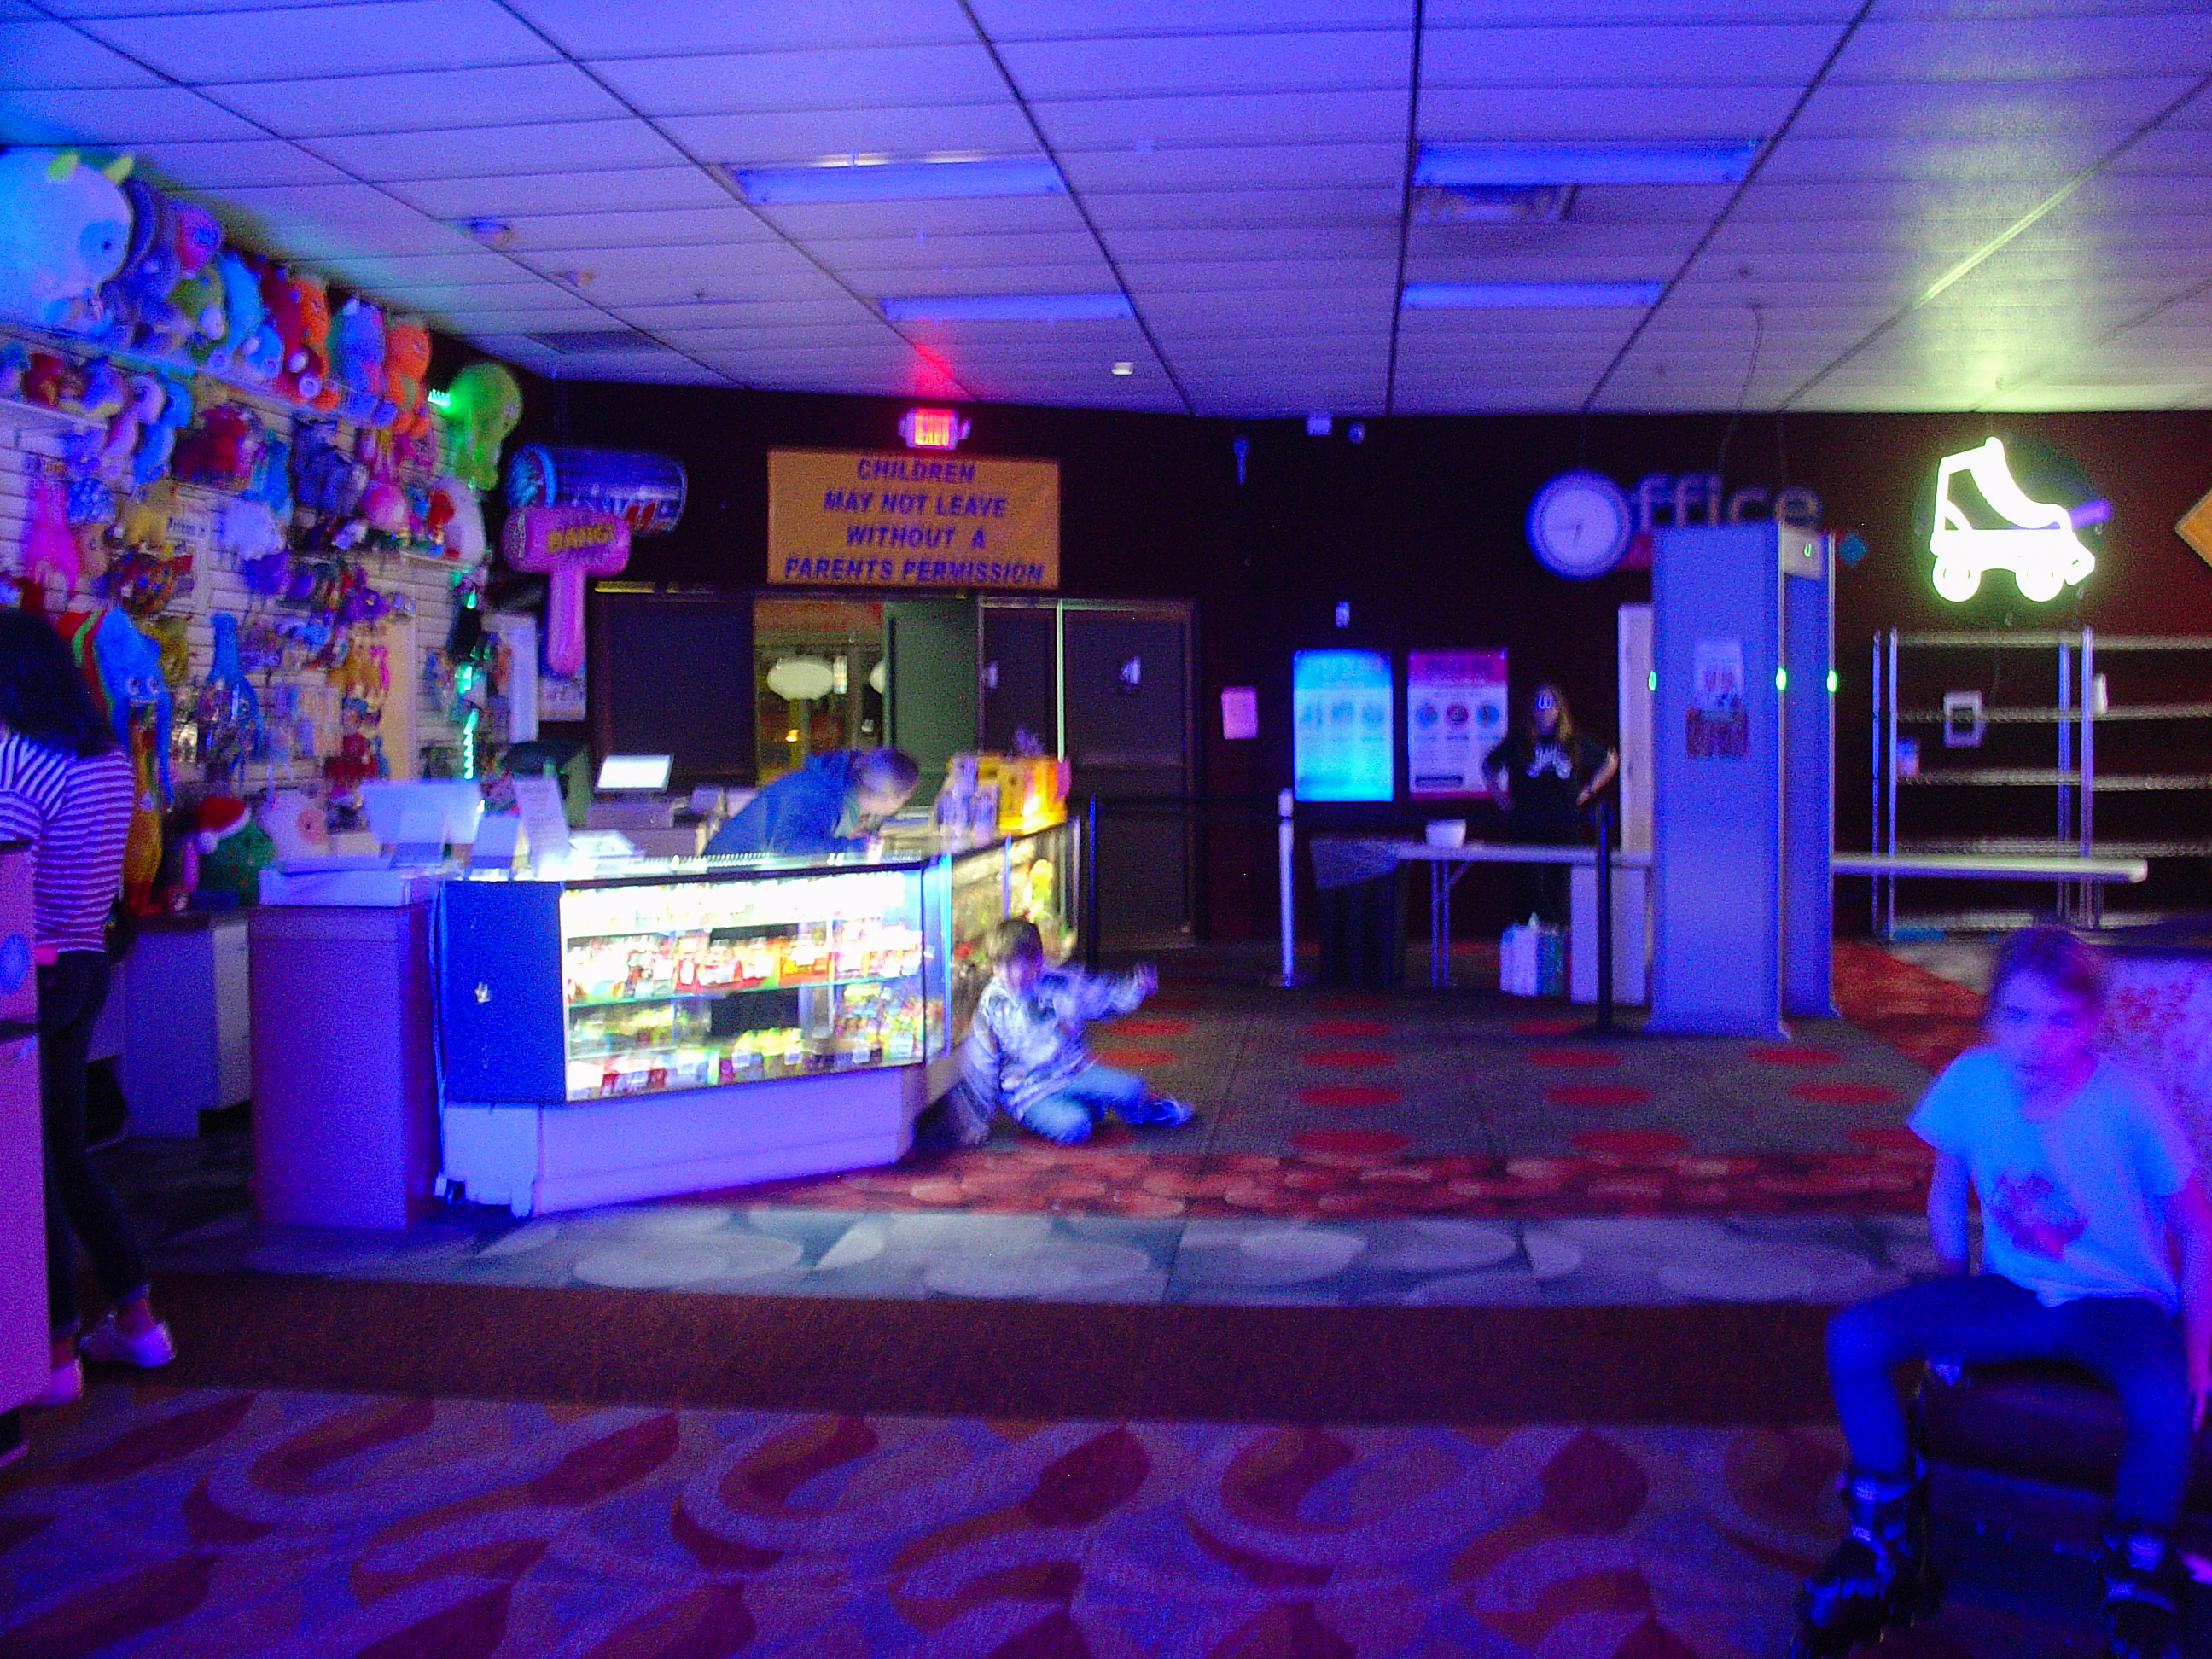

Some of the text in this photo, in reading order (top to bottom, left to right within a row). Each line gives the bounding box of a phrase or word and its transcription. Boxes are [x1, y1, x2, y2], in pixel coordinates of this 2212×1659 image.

[857, 457, 975, 484] CHILDREN
[824, 489, 1007, 517] MAY NOT LEAVE
[1625, 473, 1822, 531] ffice
[846, 525, 986, 550] WITHOUT A
[783, 556, 1045, 584] PARENTS PERMISSION
